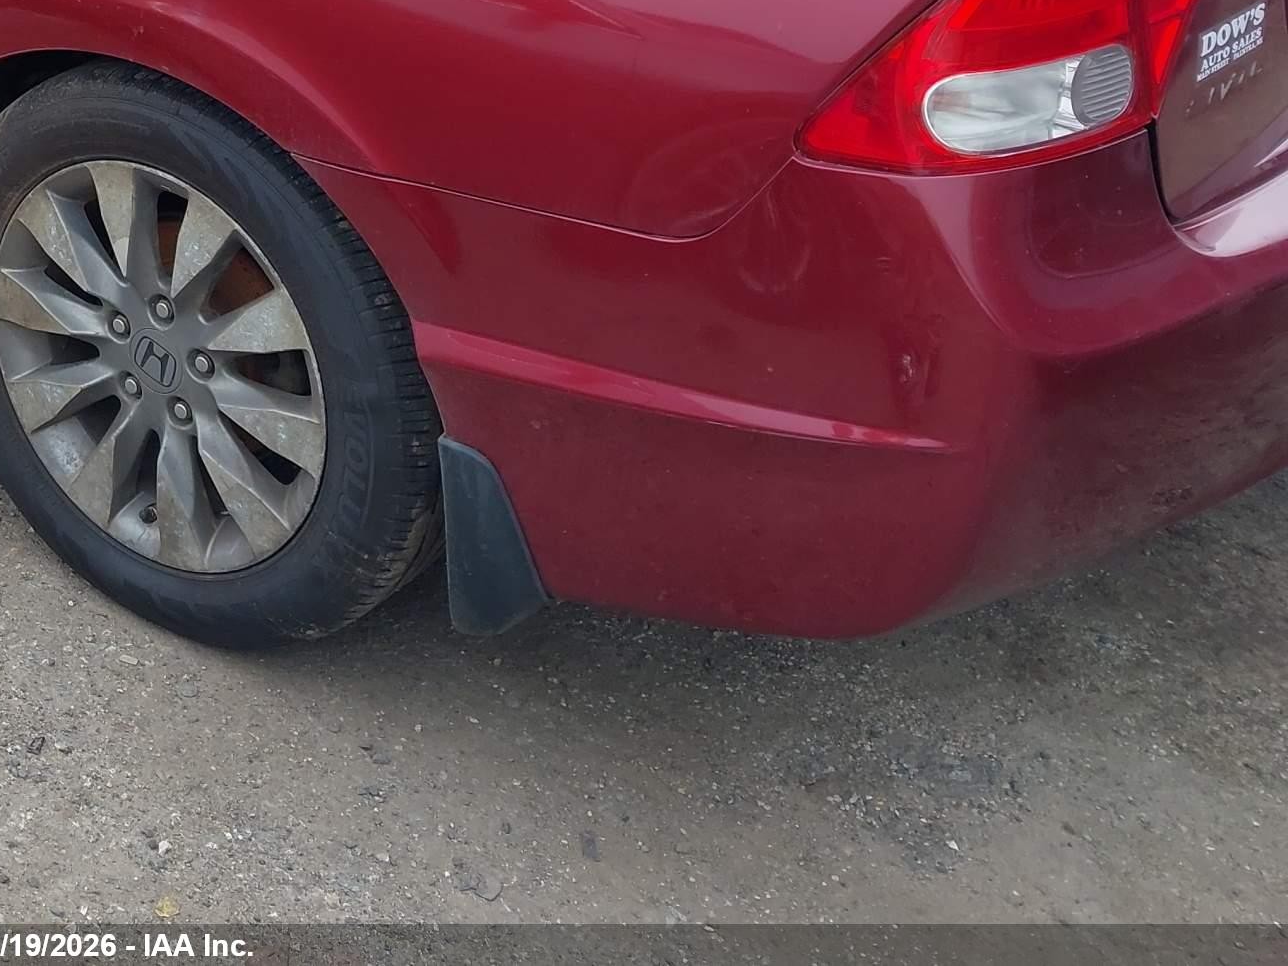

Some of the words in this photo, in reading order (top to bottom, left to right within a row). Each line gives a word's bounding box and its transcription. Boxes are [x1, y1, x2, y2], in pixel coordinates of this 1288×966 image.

[1200, 2, 1266, 57] DOW'S
[1200, 46, 1231, 73] AUTO
[1231, 26, 1263, 53] SALES
